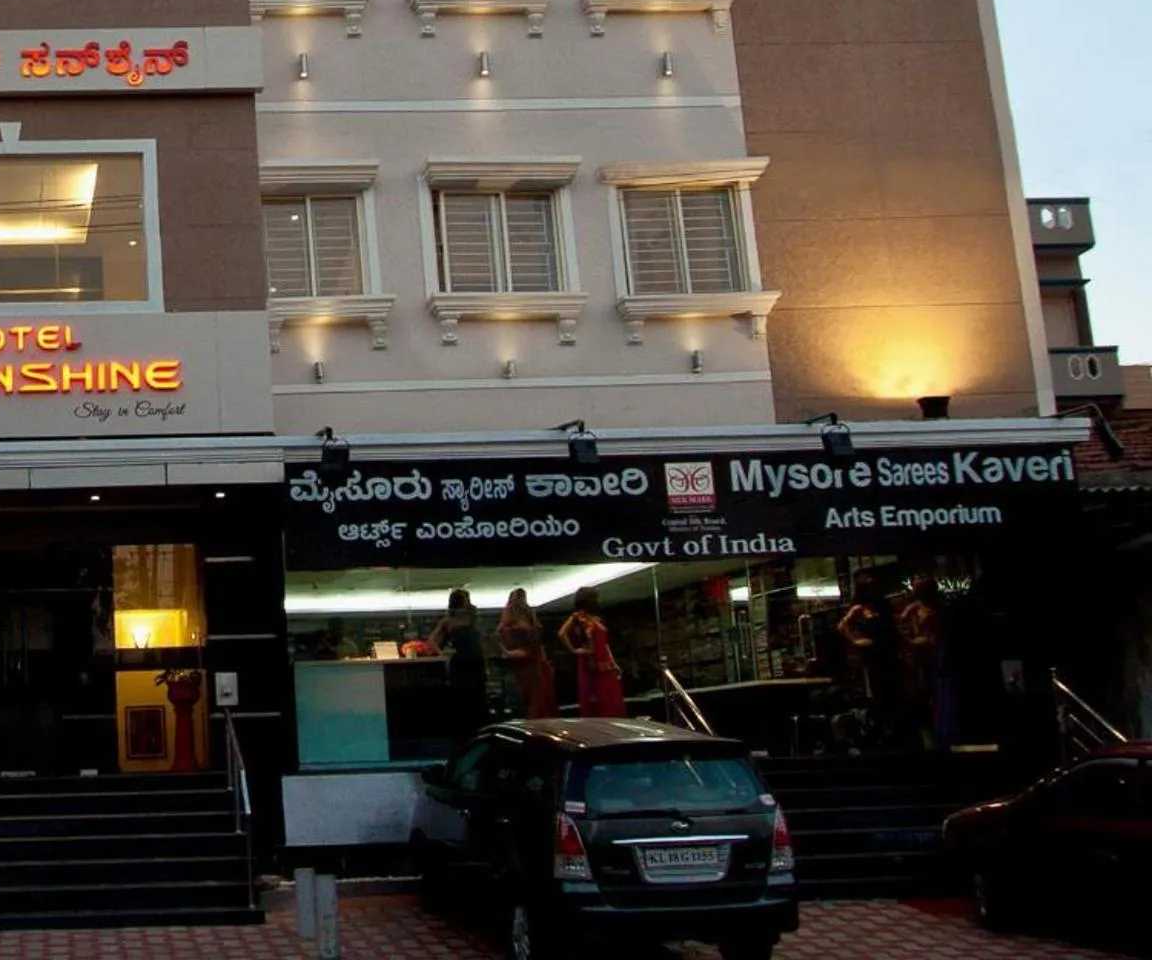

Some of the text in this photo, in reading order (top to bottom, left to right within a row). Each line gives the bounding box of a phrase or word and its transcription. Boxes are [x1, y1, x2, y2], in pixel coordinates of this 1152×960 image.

[74, 401, 111, 422] Stay
[134, 400, 187, 421] Comfort
[524, 467, 649, 498] ಕಾವೇರಿ
[729, 447, 1076, 498] Mysore Sarees Kaveri
[825, 504, 1003, 531] Arts Emporium
[601, 532, 797, 558] Govt of India
